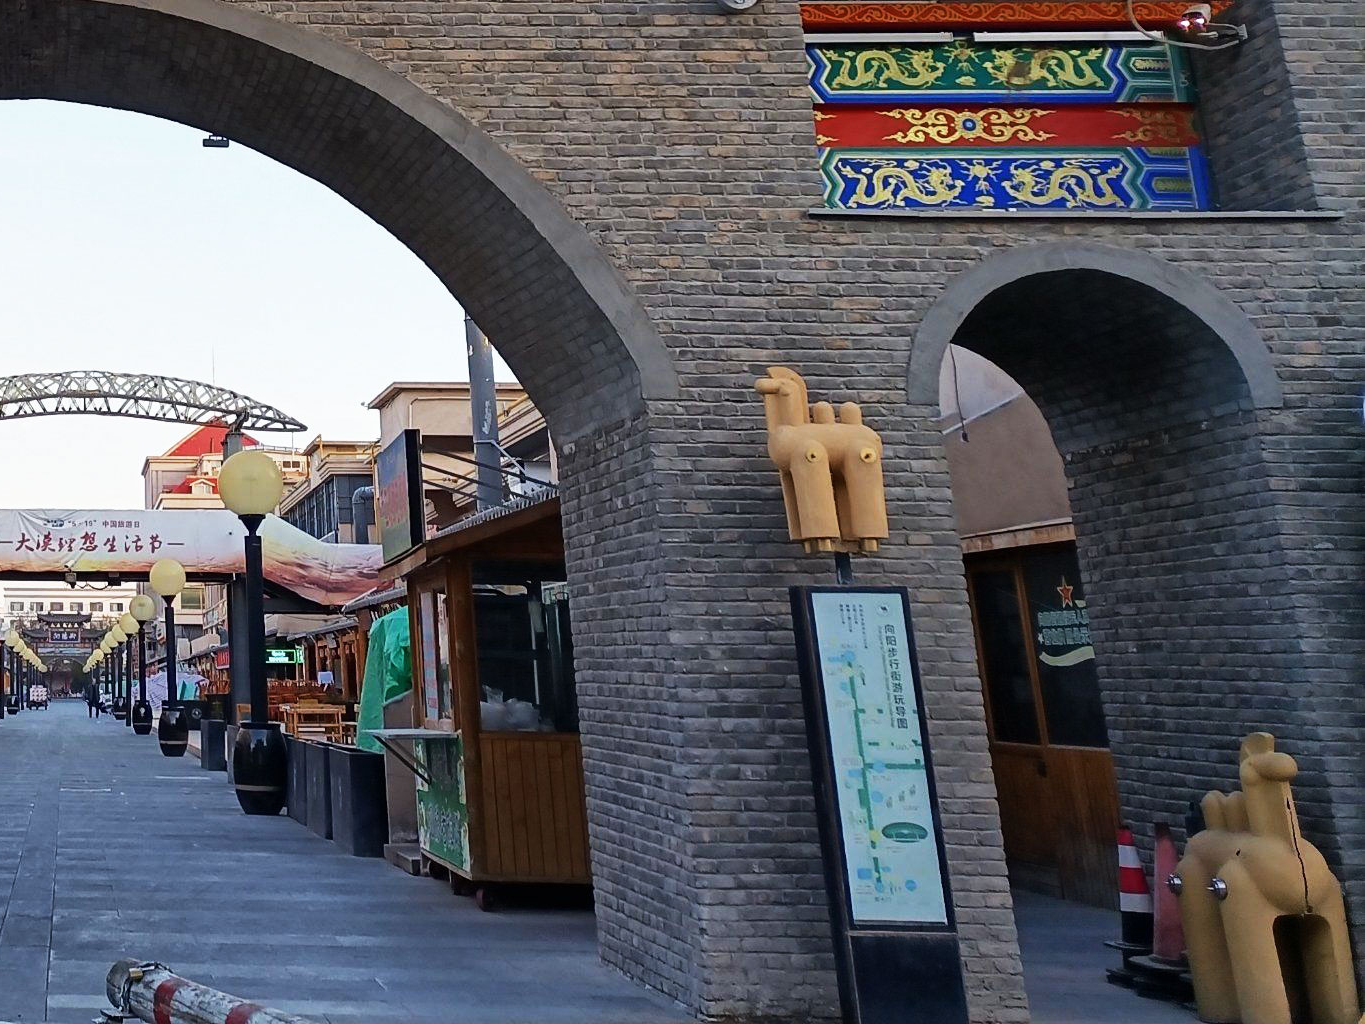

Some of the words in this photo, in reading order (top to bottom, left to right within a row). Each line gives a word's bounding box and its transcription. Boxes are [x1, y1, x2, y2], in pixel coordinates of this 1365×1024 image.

[101, 519, 141, 528] 中国旅游日
[884, 623, 909, 730] 向阳步行街游玩导图
